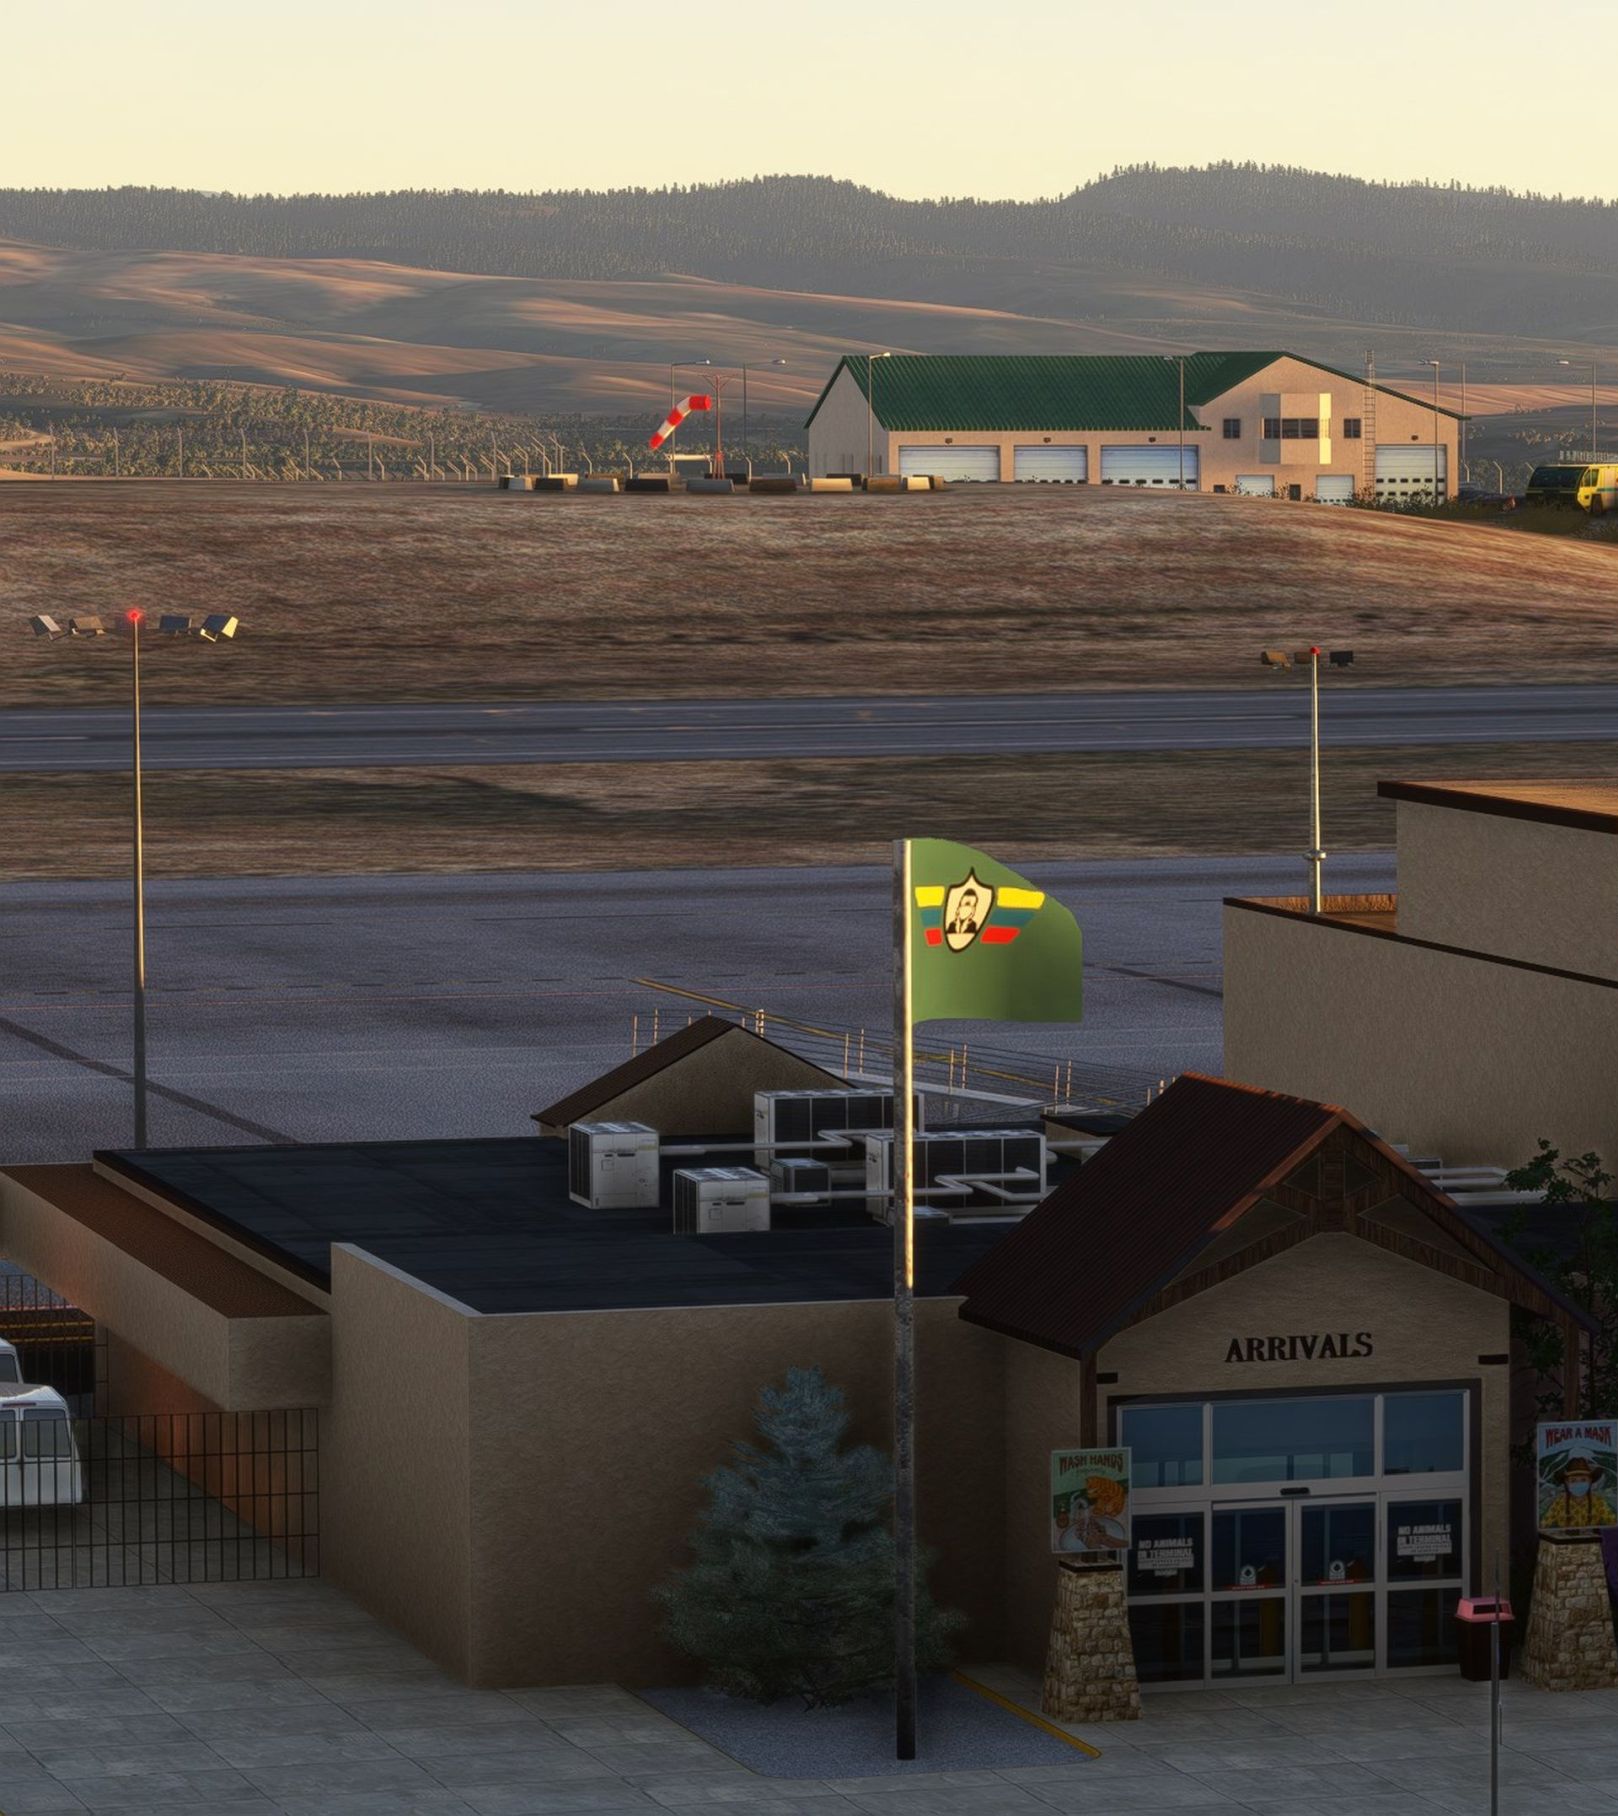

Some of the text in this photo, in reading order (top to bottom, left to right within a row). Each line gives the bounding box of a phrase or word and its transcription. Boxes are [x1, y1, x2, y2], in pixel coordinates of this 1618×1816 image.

[1225, 1332, 1373, 1363] ARRIVALS
[1545, 1426, 1612, 1448] WEAR A MASK
[1058, 1453, 1124, 1476] WASH HANDS
[1398, 1523, 1451, 1535] NO ANIMALS
[1138, 1537, 1193, 1549] NO ANIMALS
[1407, 1533, 1451, 1543] TERMINAL
[1147, 1547, 1192, 1558] TERMINAL
